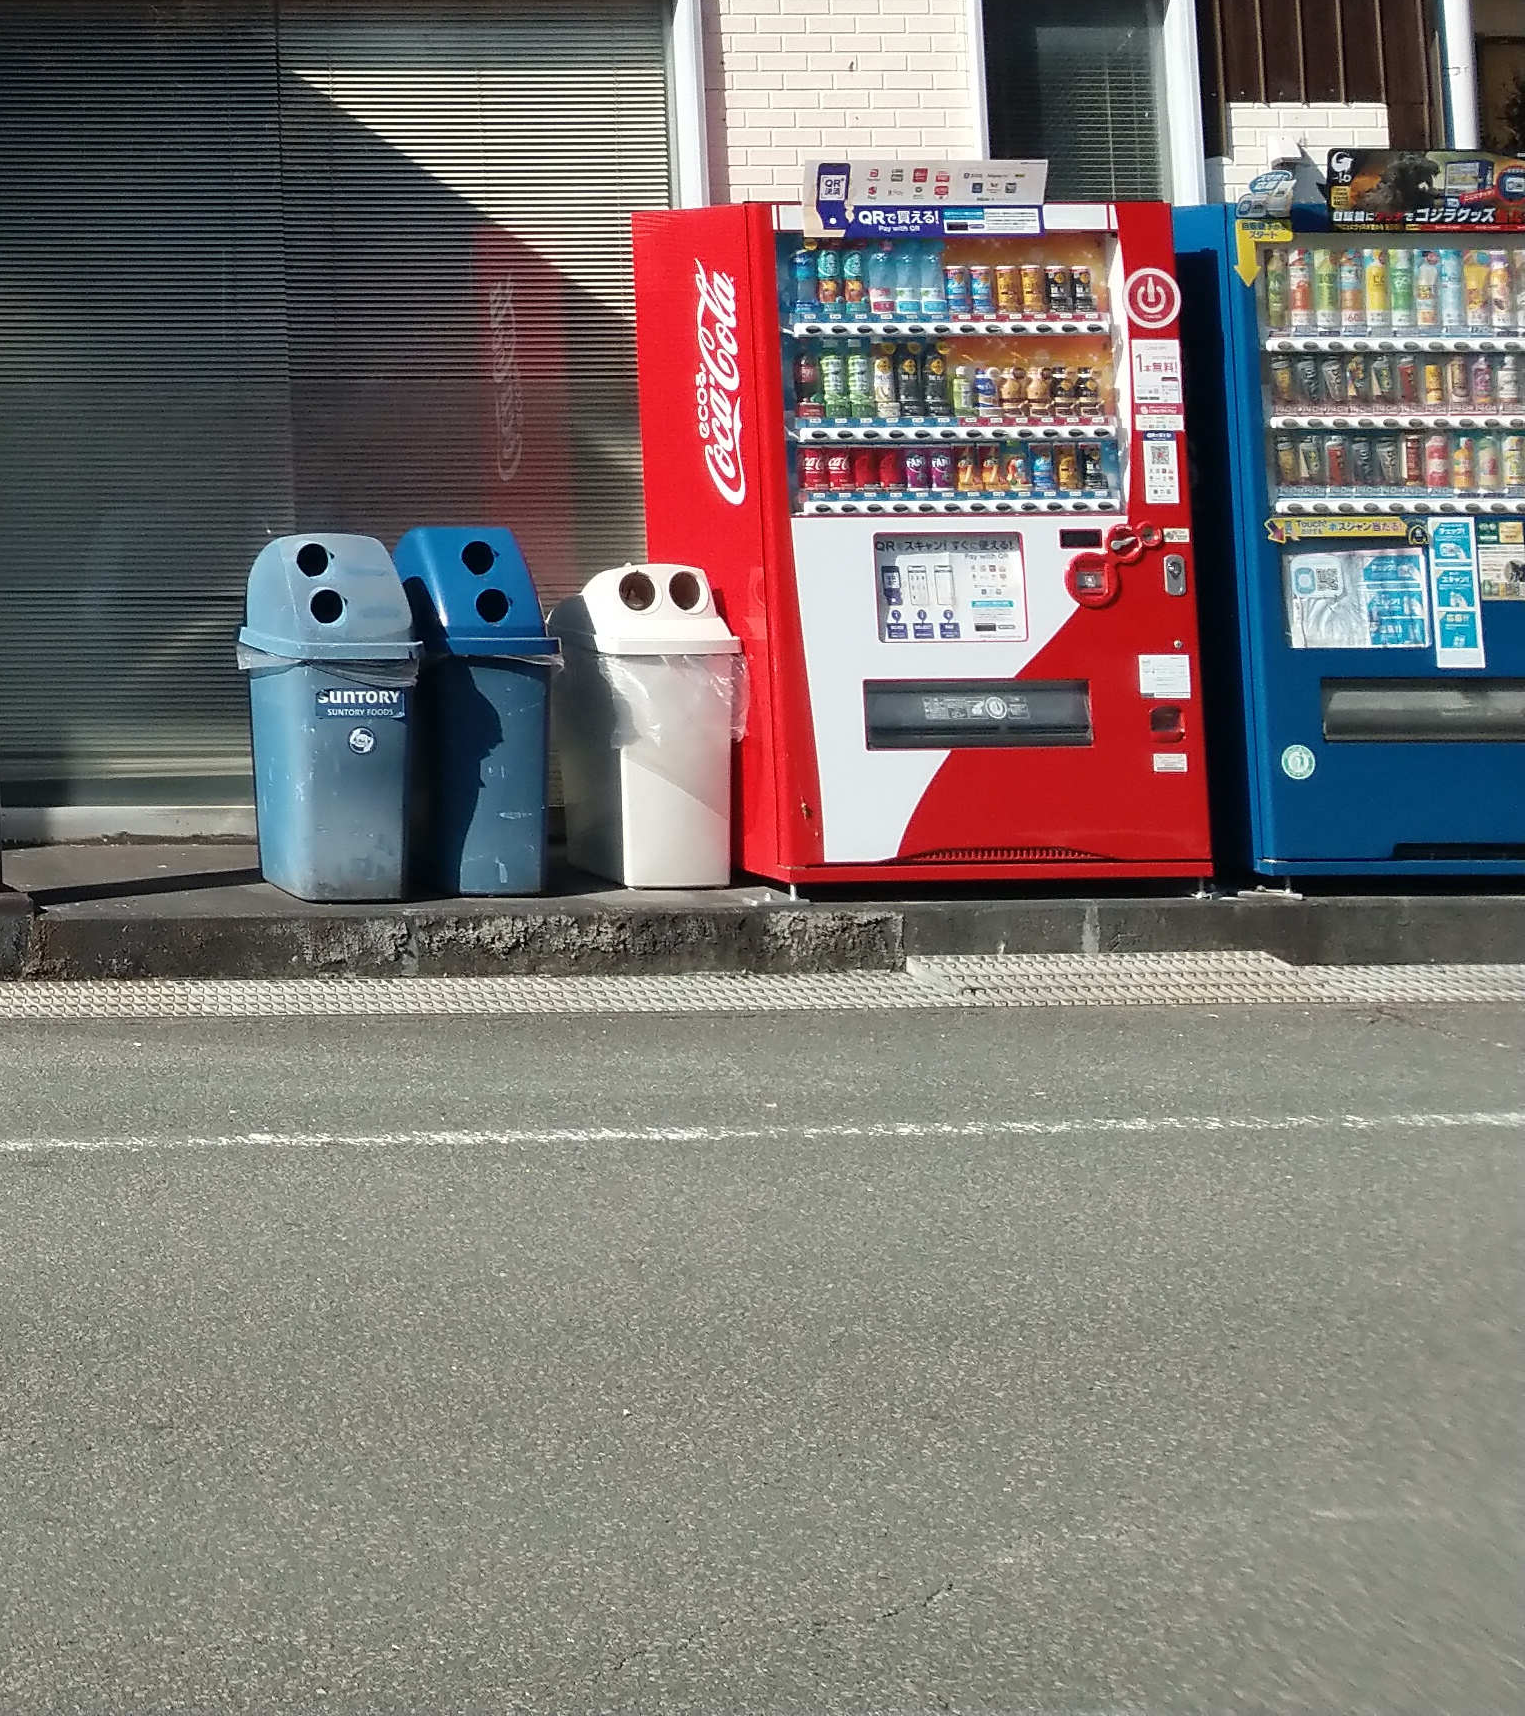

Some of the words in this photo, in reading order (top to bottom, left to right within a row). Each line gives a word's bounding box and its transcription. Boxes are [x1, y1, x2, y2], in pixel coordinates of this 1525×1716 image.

[858, 210, 940, 226] QRで買える!
[695, 257, 746, 505] Coca-Cola
[317, 690, 401, 704] SUNTORY
[327, 708, 365, 717] SUNTORY
[366, 708, 394, 716] FOODS
